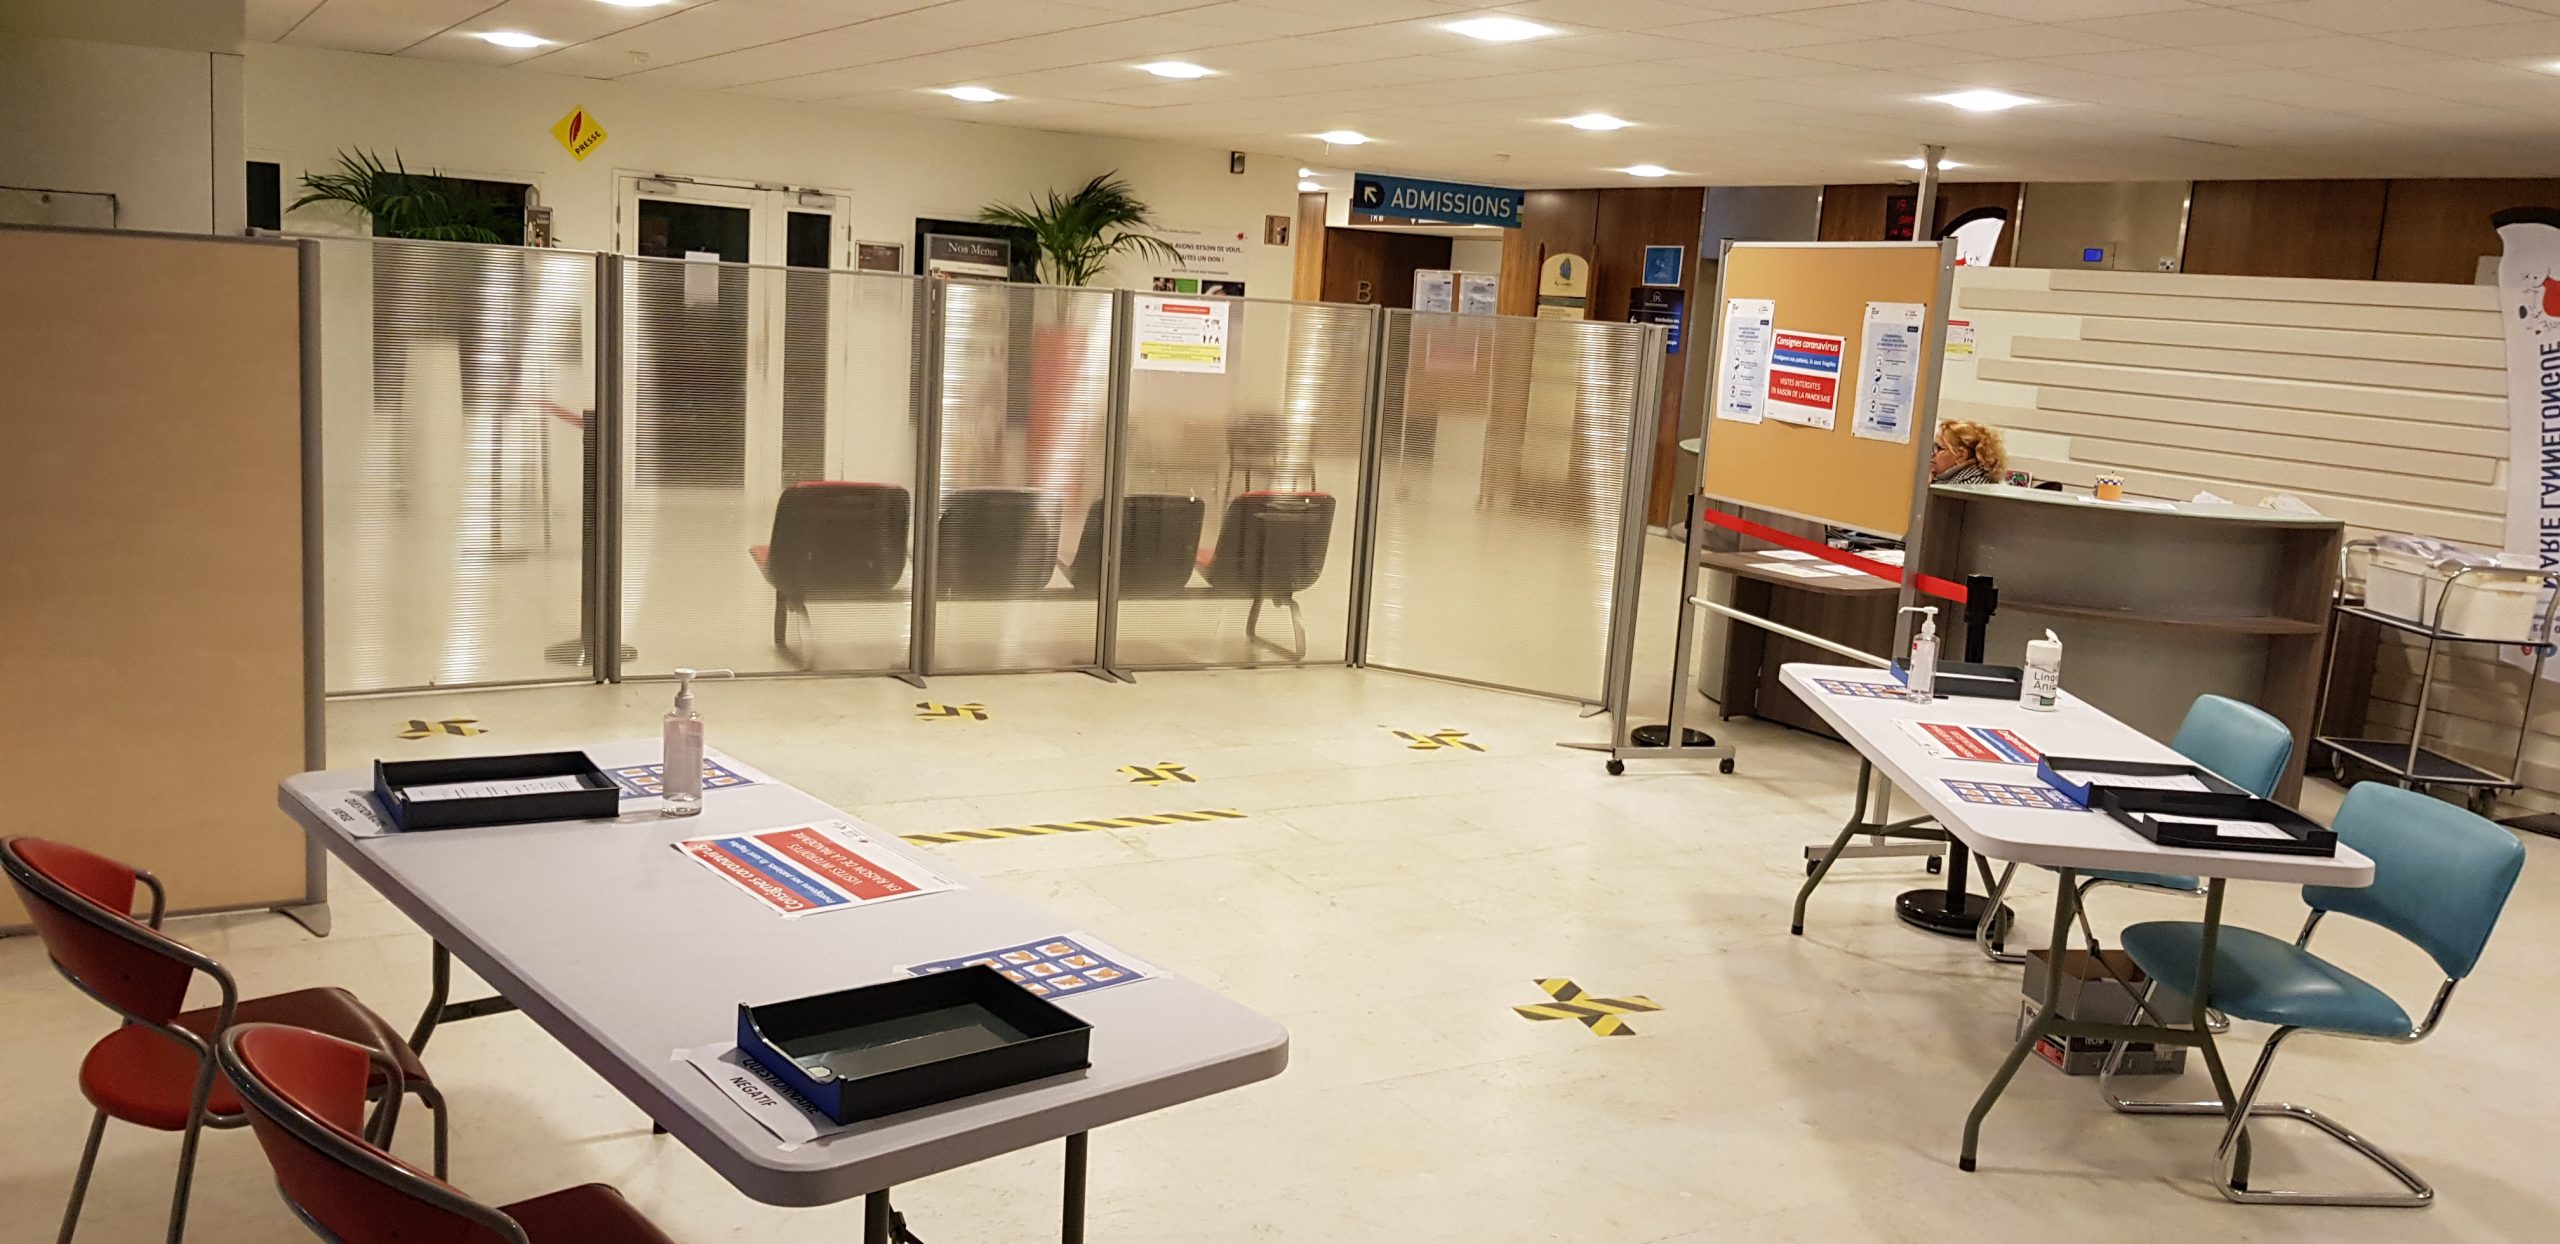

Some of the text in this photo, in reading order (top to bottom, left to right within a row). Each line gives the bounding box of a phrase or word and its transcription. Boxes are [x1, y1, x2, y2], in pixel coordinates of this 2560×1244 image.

[574, 130, 602, 155] PRESSE
[1390, 187, 1511, 218] ADMISSIONS
[948, 241, 998, 257] Nos Menus
[1356, 280, 1372, 303] B
[1776, 336, 1839, 352] Consignes coronavirus
[695, 843, 805, 910] Consignes coronavirus
[786, 844, 864, 886] VISITES INTERDITES
[790, 832, 903, 892] EN RAISON DE LA PANDEMIE
[729, 1076, 778, 1108] NEGATIF
[742, 1057, 820, 1116] QUESTIONNAIRE
